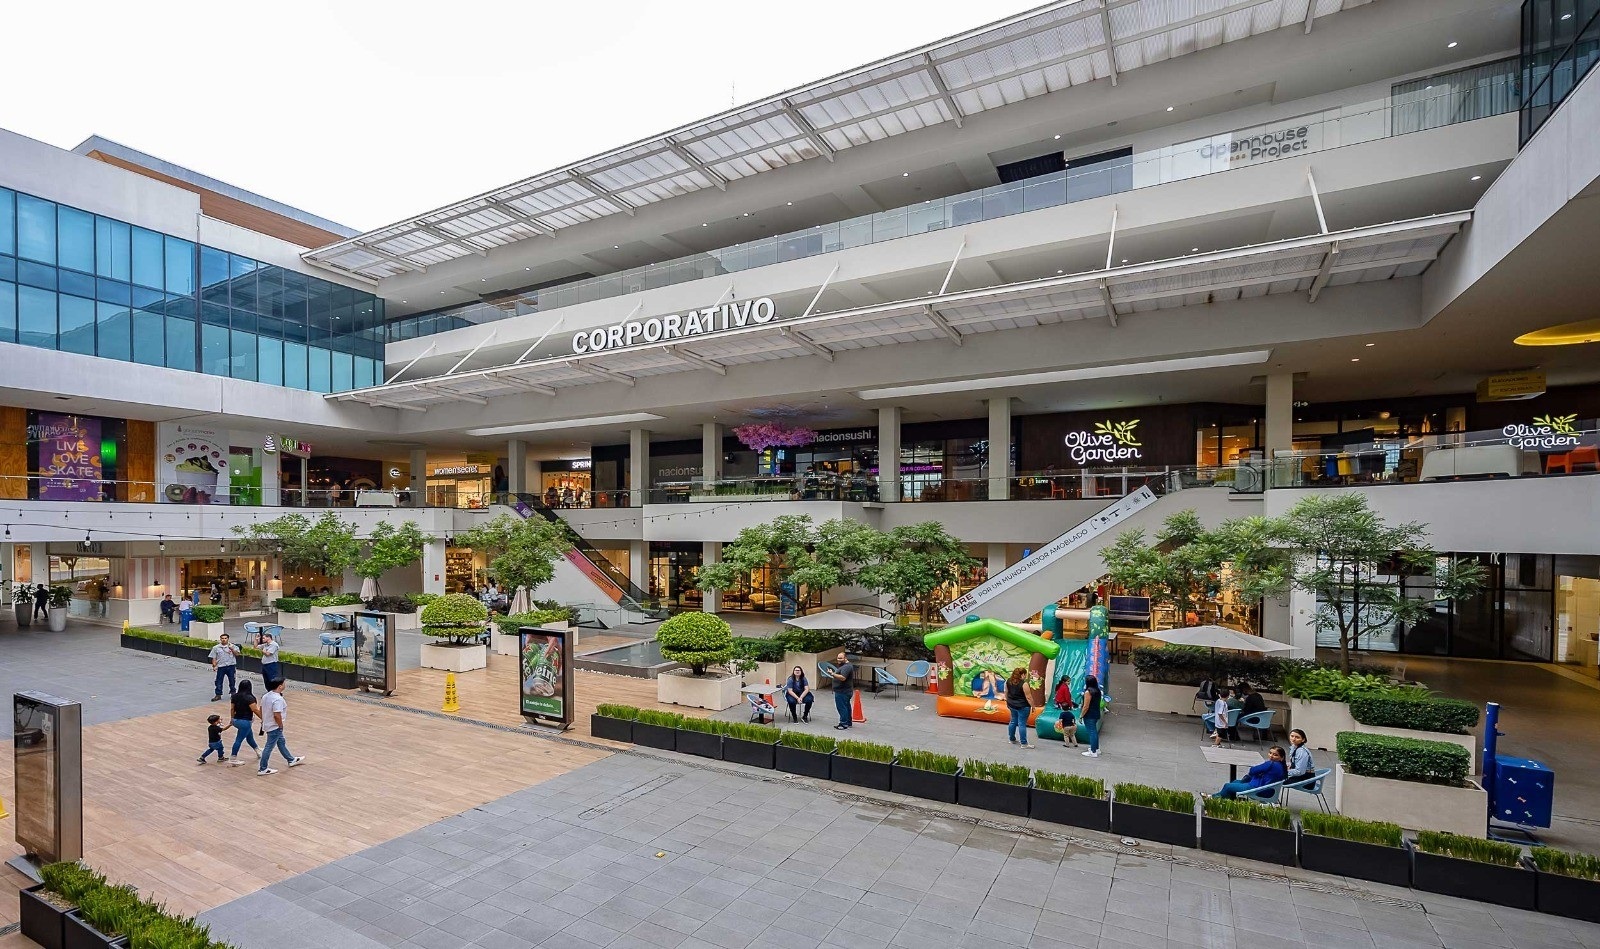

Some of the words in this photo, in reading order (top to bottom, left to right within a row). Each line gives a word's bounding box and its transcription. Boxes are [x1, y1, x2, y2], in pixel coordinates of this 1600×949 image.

[1251, 139, 1308, 160] Project
[572, 297, 776, 354] CORPORATIVO
[812, 430, 872, 443] nacionsushi
[1503, 424, 1551, 437] Olive
[56, 441, 89, 452] LIVE
[1065, 431, 1113, 447] Olive
[1509, 435, 1581, 450] Garden
[53, 453, 89, 465] LOVE
[1071, 444, 1142, 464] Garden
[48, 464, 94, 477] SKATE
[978, 587, 992, 598] POR
[992, 581, 1003, 590] UN
[1002, 566, 1027, 584] MUNDO
[1026, 552, 1050, 569] MEJOR
[1049, 528, 1089, 556] AMOBLADO
[945, 593, 974, 613] KARE
